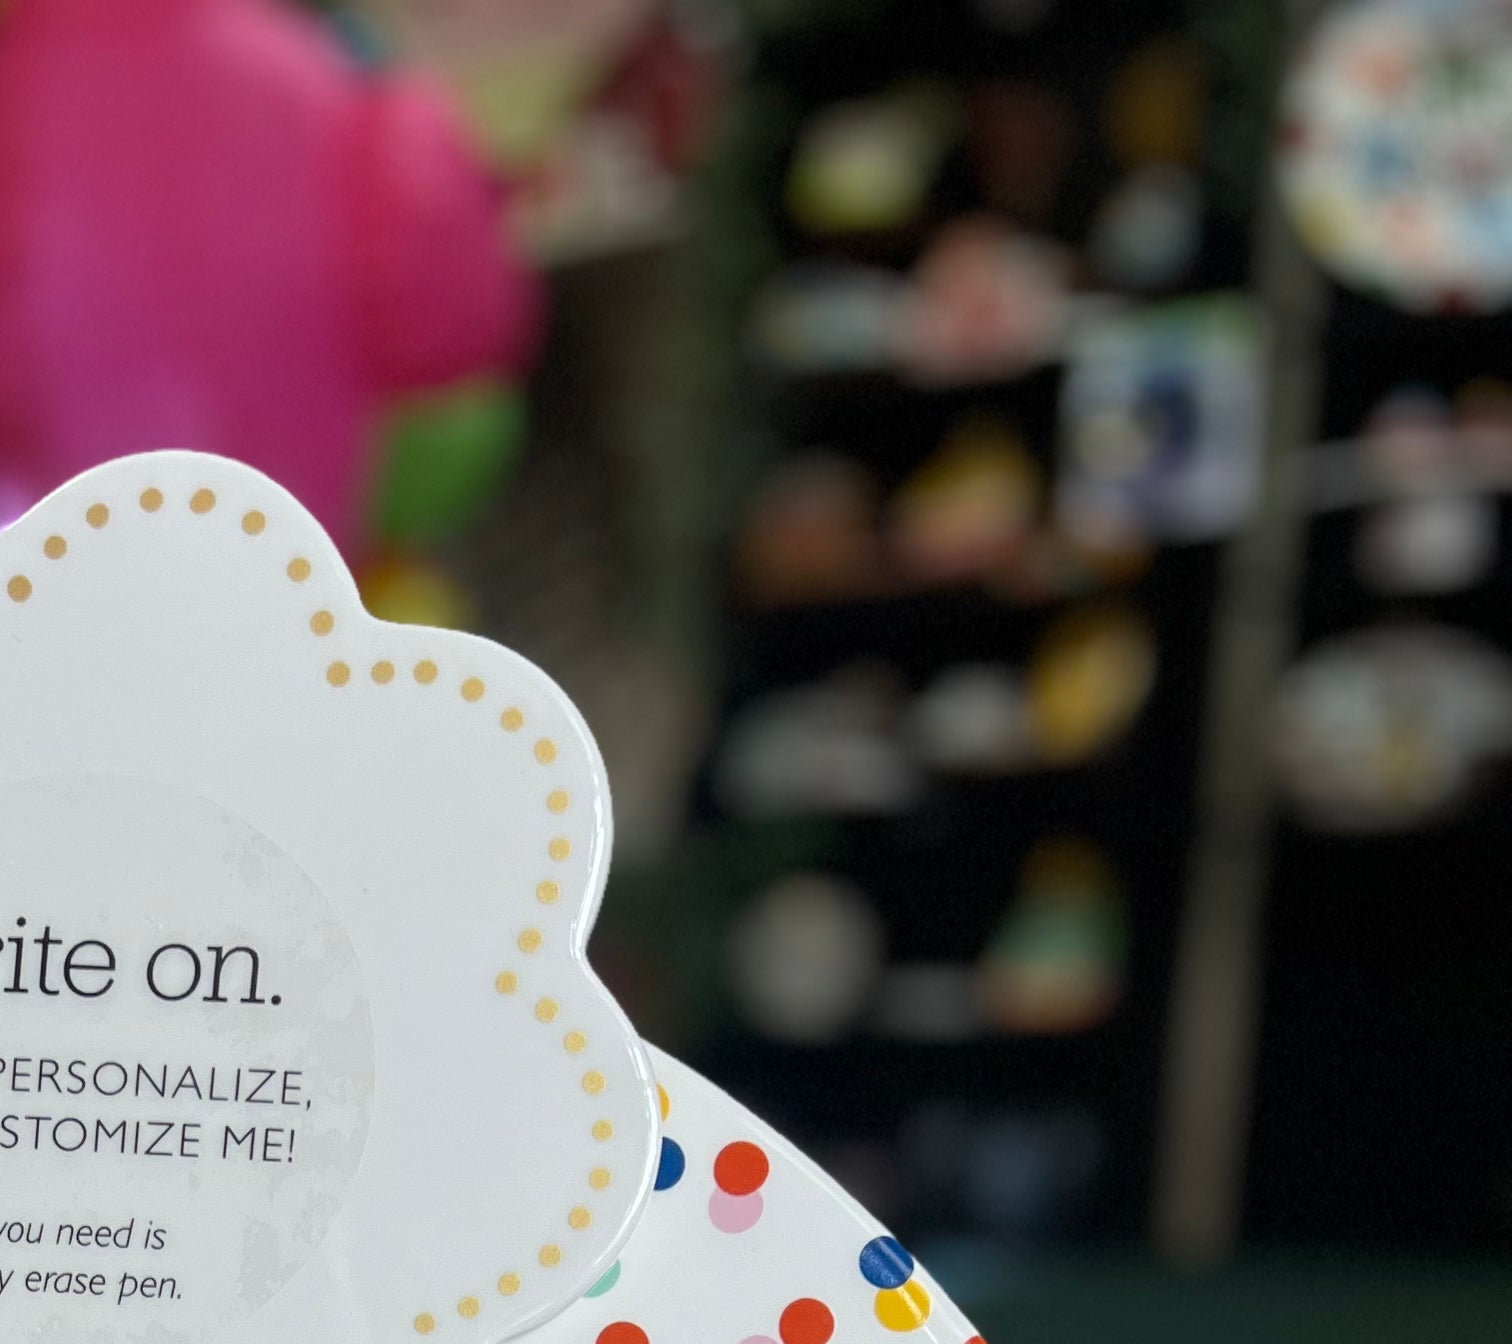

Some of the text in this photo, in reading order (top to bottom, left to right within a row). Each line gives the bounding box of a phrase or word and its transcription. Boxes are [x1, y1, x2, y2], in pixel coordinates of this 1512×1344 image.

[146, 943, 282, 1006] on.
[222, 1125, 295, 1163] ME!
[55, 1217, 135, 1249] need
[143, 1220, 167, 1251] is
[24, 1270, 106, 1296] erase
[117, 1272, 182, 1306] pen.
